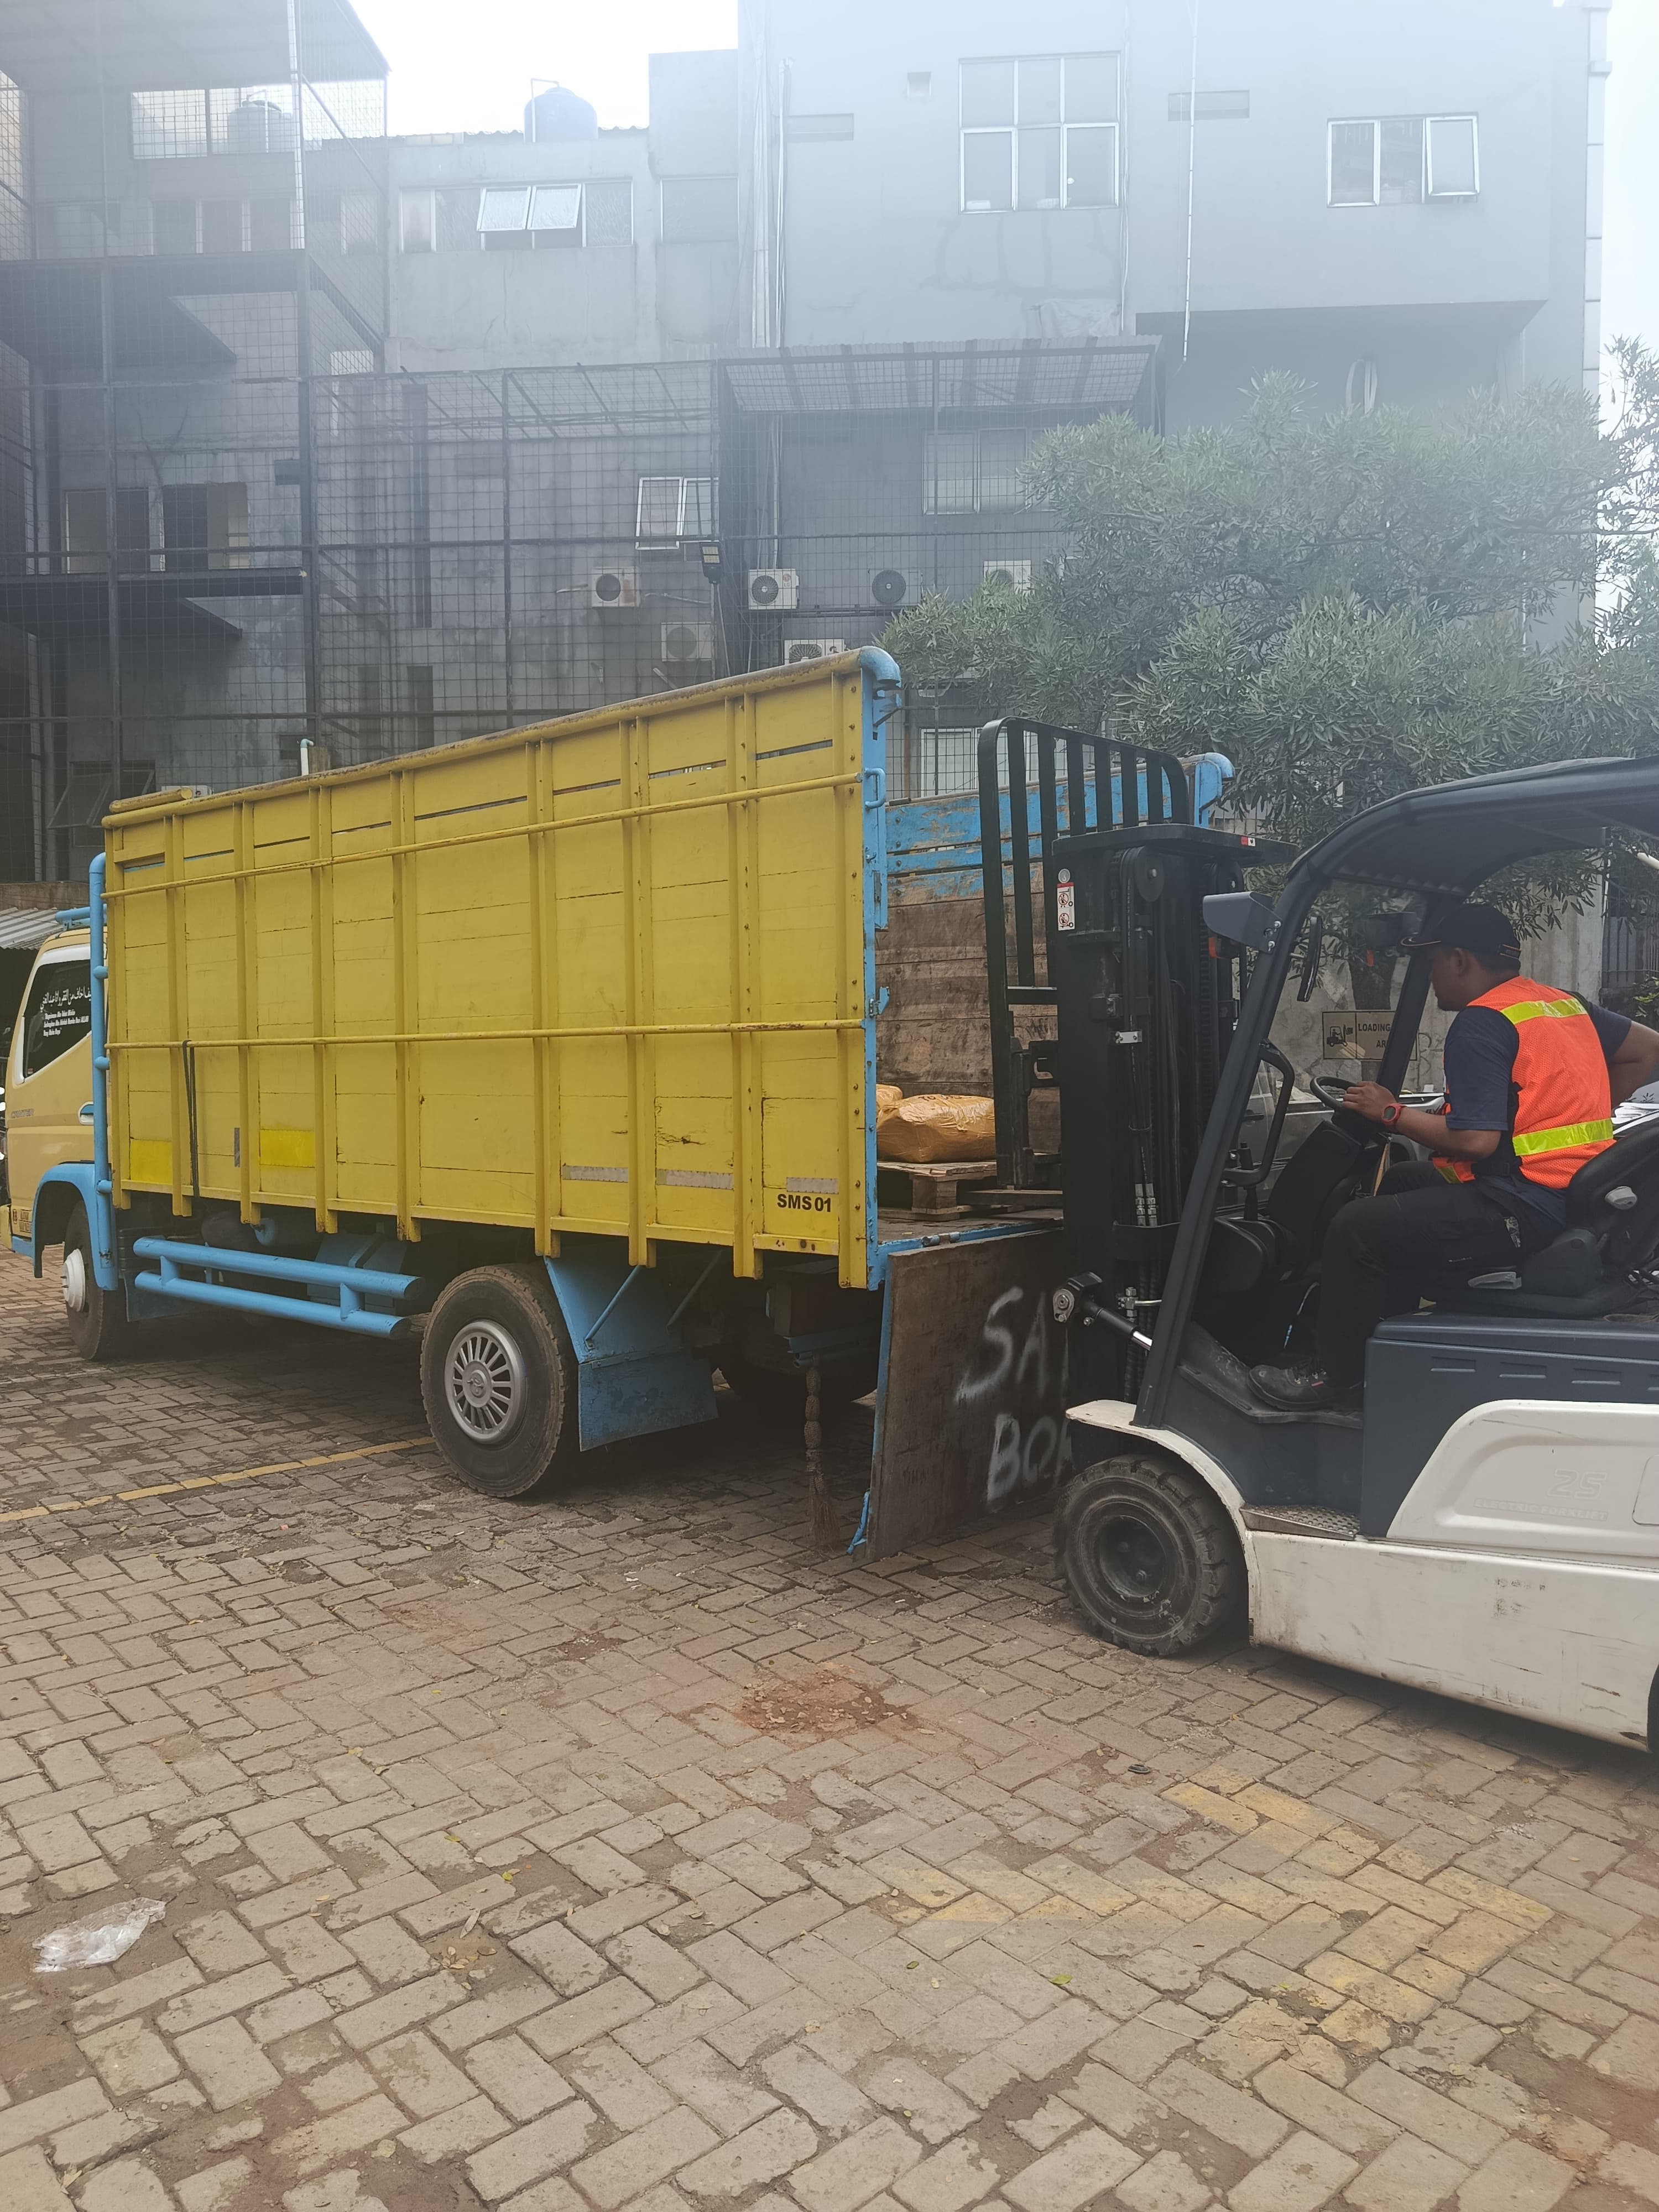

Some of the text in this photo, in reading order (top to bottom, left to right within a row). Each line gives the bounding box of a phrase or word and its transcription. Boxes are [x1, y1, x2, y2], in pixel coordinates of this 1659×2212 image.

[955, 1286, 1069, 1406] SA
[1547, 1468, 1608, 1500] 25
[1475, 1498, 1608, 1520] ELECTRIC FORKLIFT
